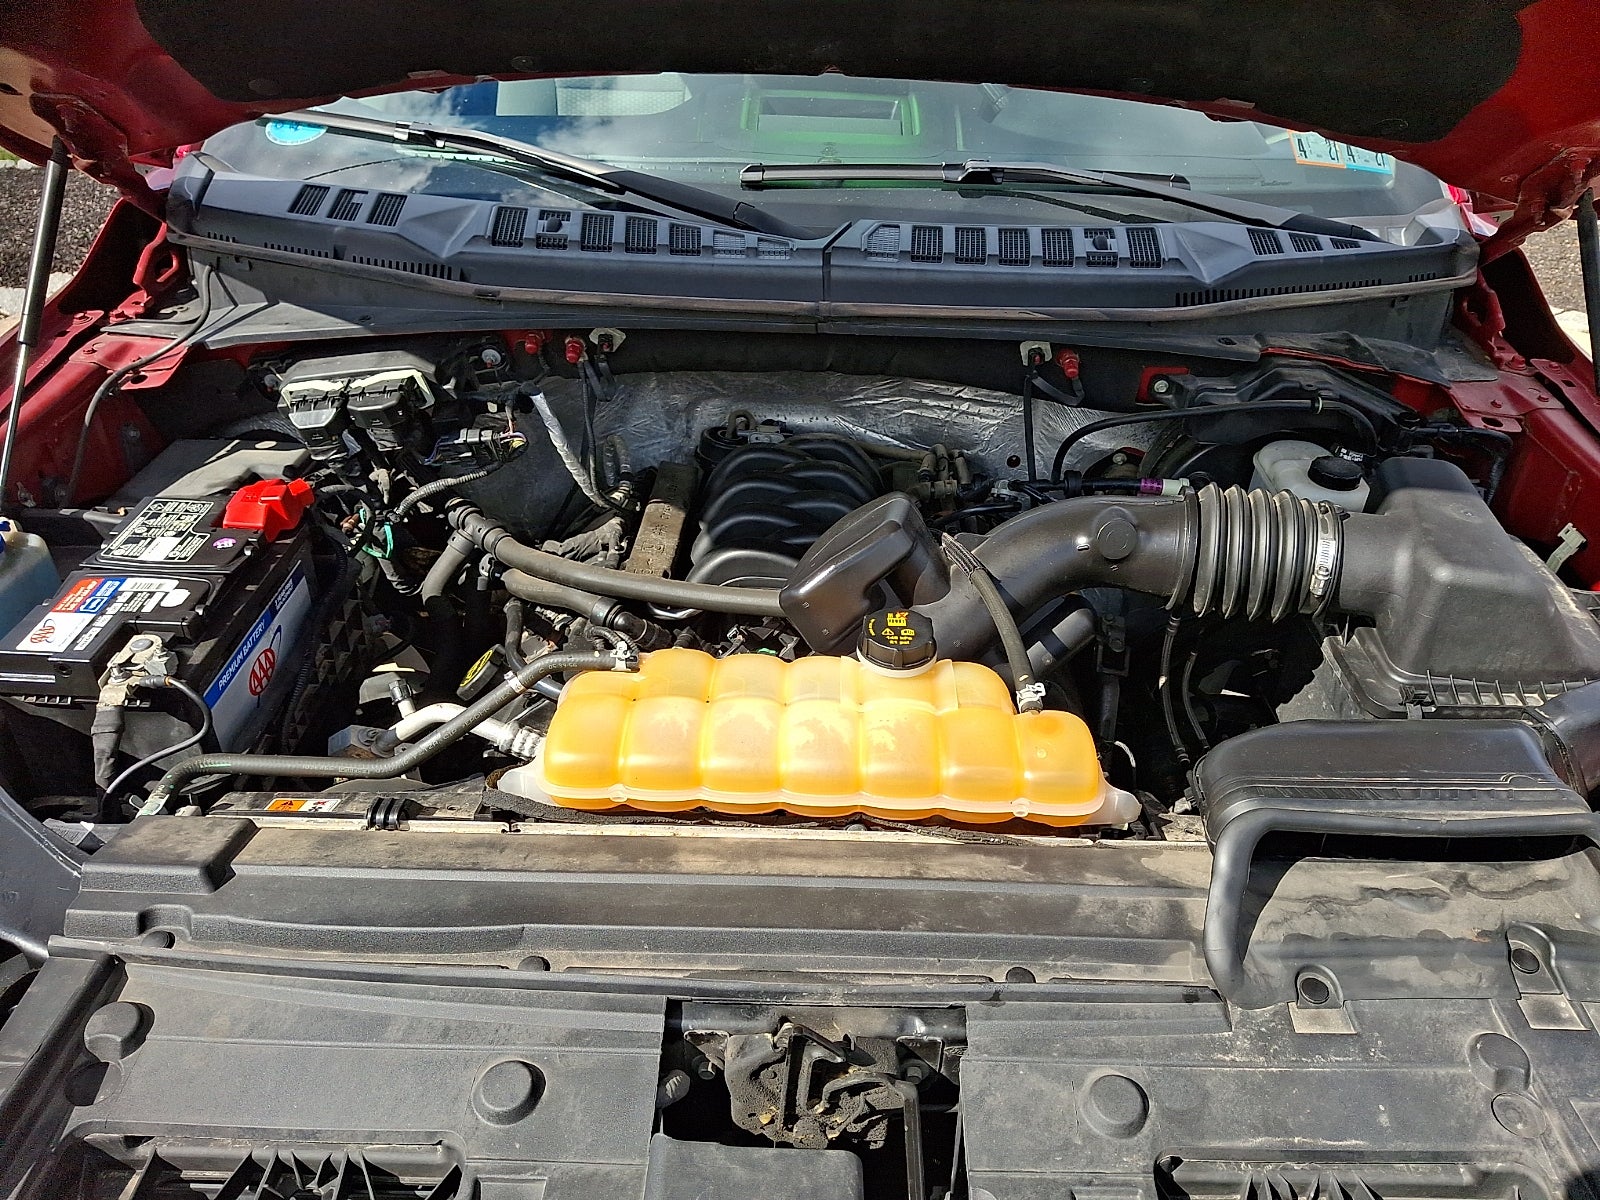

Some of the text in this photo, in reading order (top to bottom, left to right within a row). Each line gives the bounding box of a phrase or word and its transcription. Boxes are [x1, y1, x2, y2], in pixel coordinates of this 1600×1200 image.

[30, 625, 55, 643] AAA
[218, 619, 265, 690] PREMIUM BATTERY
[249, 648, 276, 696] AAA
